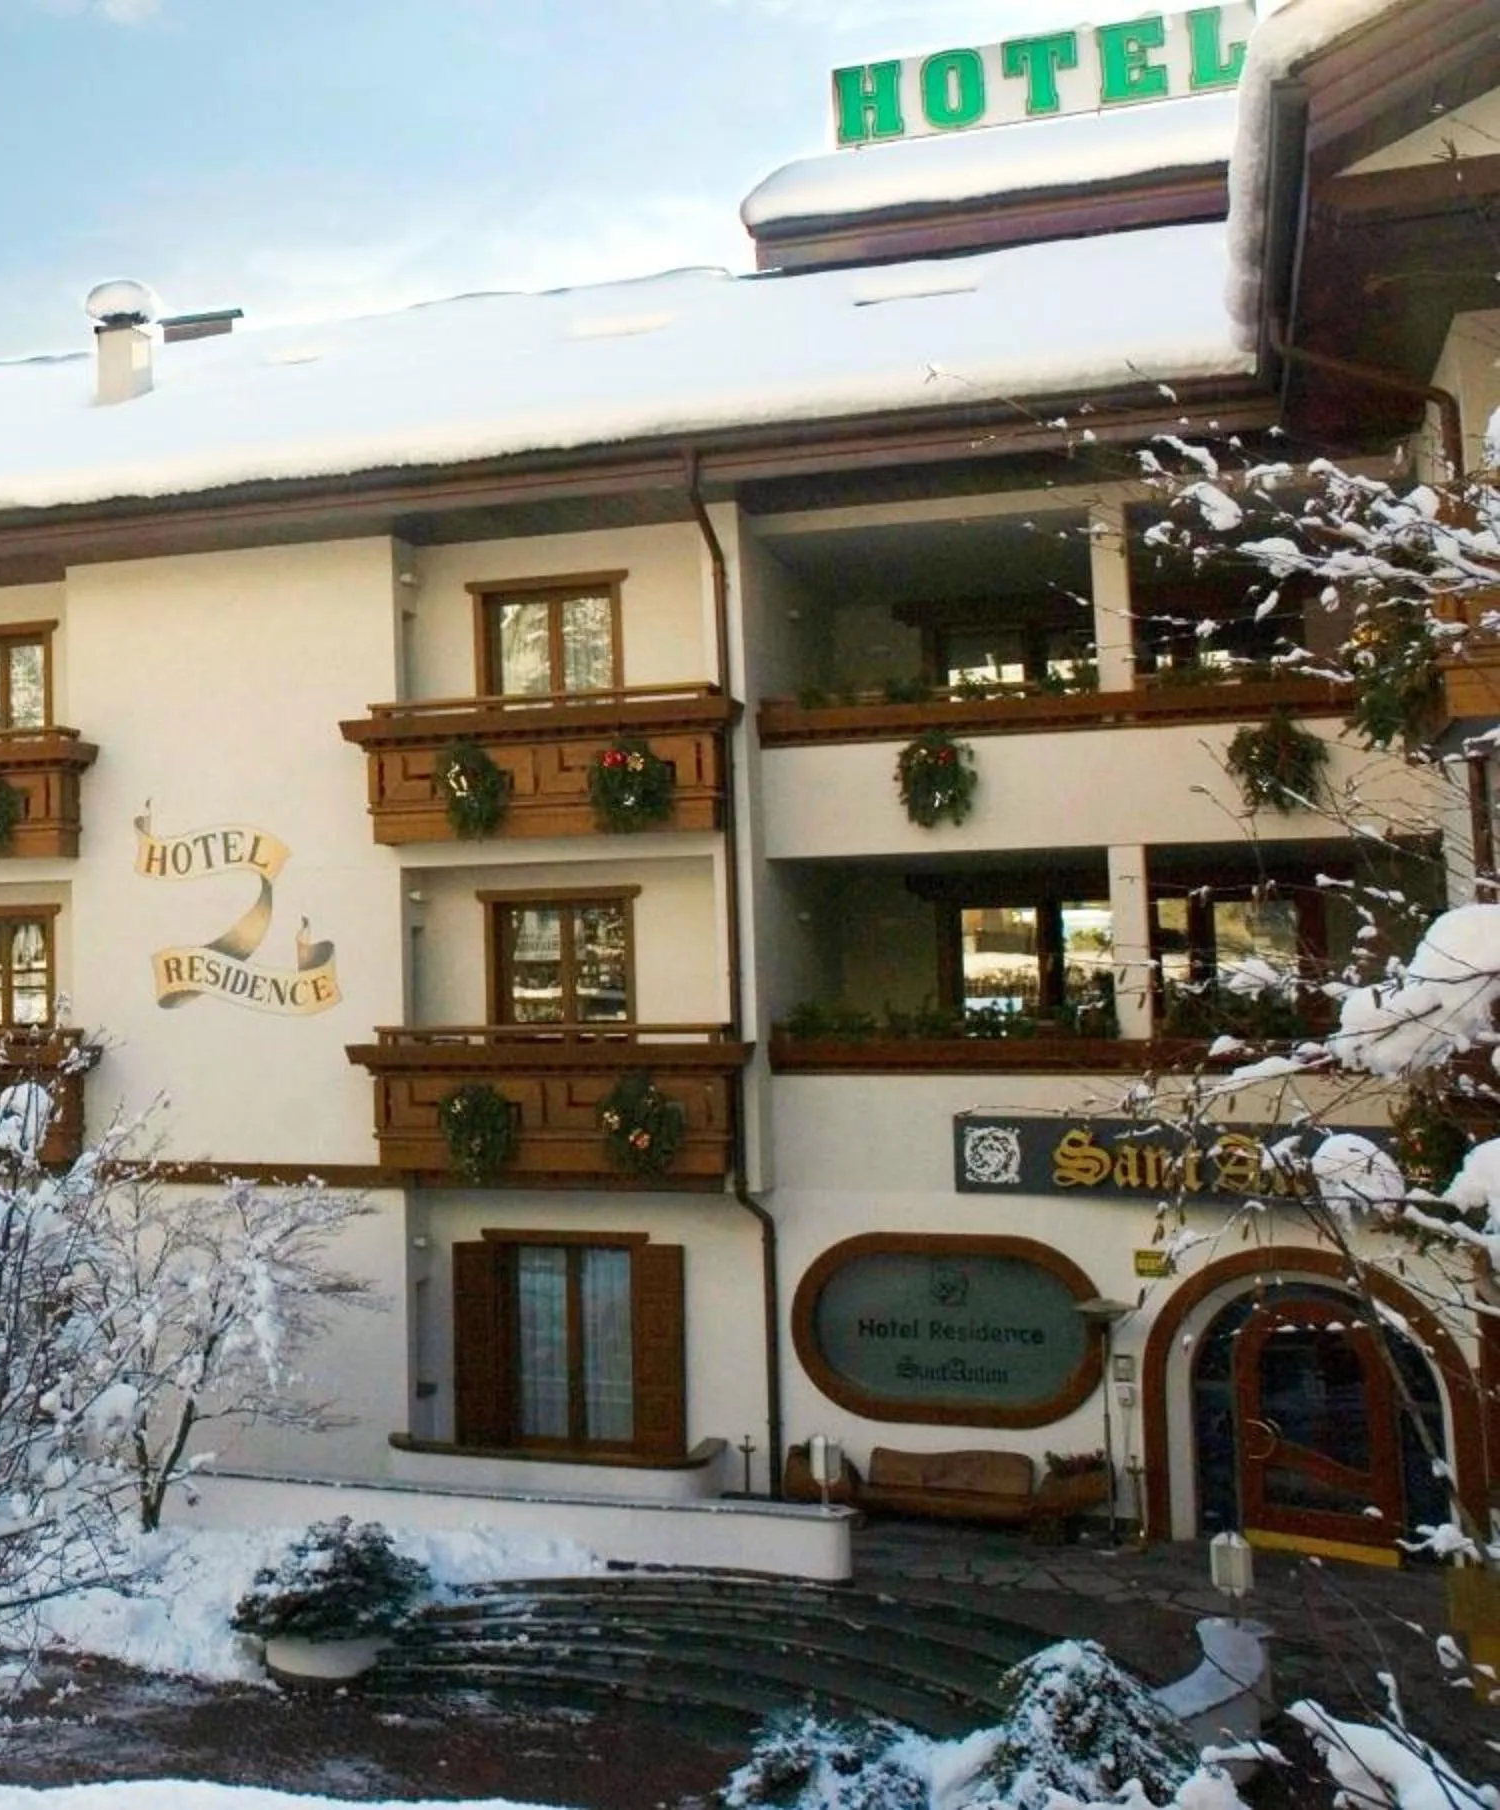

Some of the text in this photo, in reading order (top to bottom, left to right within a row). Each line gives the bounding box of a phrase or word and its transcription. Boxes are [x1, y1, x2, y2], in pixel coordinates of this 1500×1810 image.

[835, 7, 1247, 144] HOTEL
[144, 830, 271, 877] HOTEL
[162, 955, 333, 1008] RESIDENCE
[857, 1317, 1046, 1346] Hotel Residence
